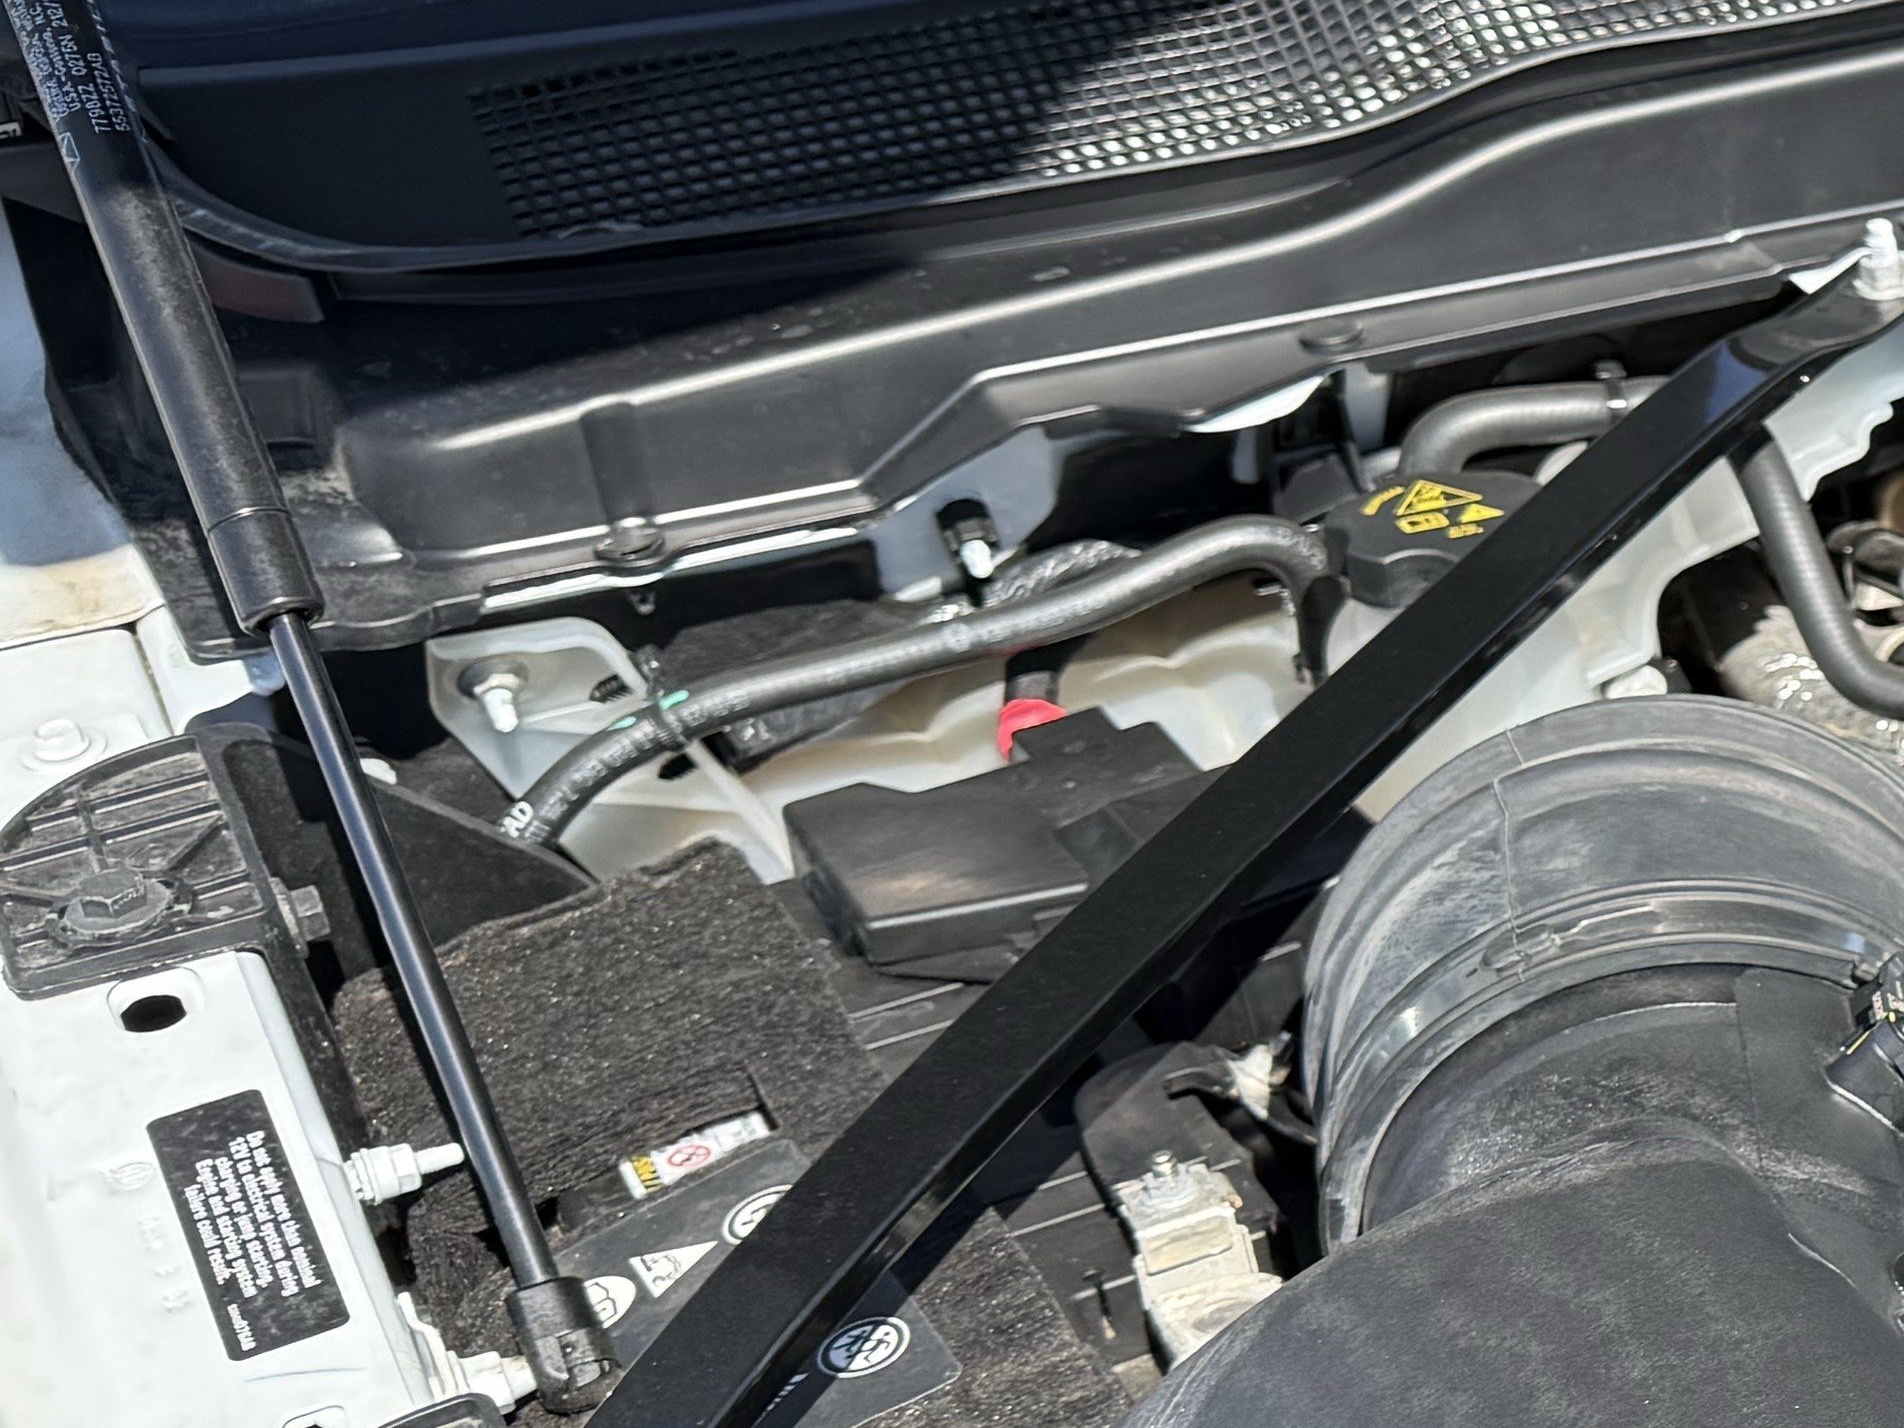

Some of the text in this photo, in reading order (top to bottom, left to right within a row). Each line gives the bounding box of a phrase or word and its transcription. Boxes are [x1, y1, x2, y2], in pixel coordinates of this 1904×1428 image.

[253, 1147, 271, 1167] not
[256, 1166, 283, 1194] apply
[184, 1184, 208, 1220] failure
[196, 1220, 222, 1248] could
[195, 1158, 257, 1298] Engine and starting system
[214, 1156, 274, 1288] charging or jump starting.
[229, 1136, 299, 1297] 12V to electrical system during
[270, 1194, 292, 1222] more
[281, 1220, 301, 1247] than
